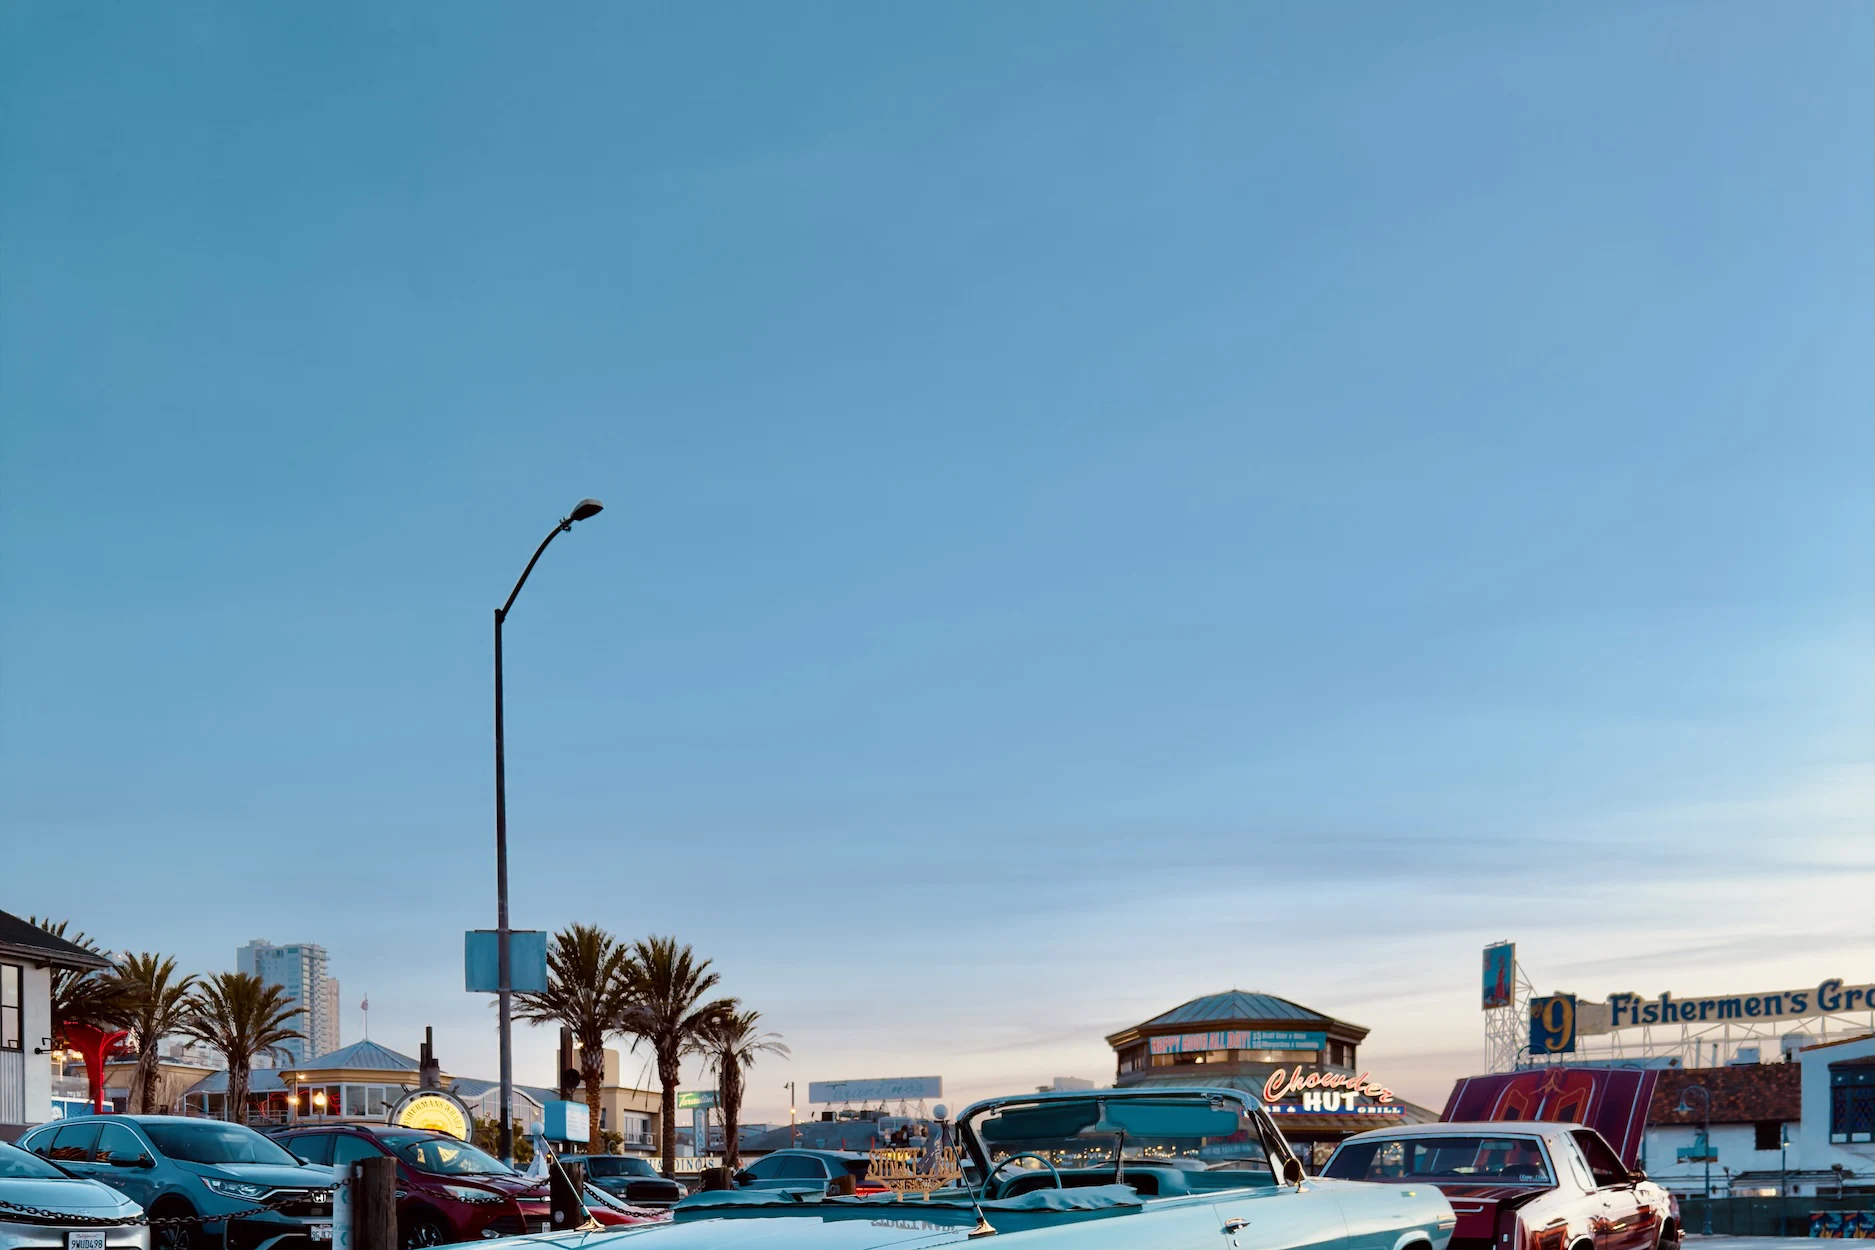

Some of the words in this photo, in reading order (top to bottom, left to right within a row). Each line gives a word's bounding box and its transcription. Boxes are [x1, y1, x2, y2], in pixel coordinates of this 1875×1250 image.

[1609, 991, 1808, 1026] Fishermen's
[1542, 997, 1574, 1050] 9
[1151, 1036, 1180, 1054] HAPPY
[1182, 1033, 1207, 1051] HOUR
[1208, 1032, 1226, 1049] ALL
[1263, 1065, 1394, 1103] Chowder
[1302, 1091, 1360, 1112] HUT
[1357, 1106, 1401, 1114] GRILL
[71, 1239, 103, 1249] 9WUD498
